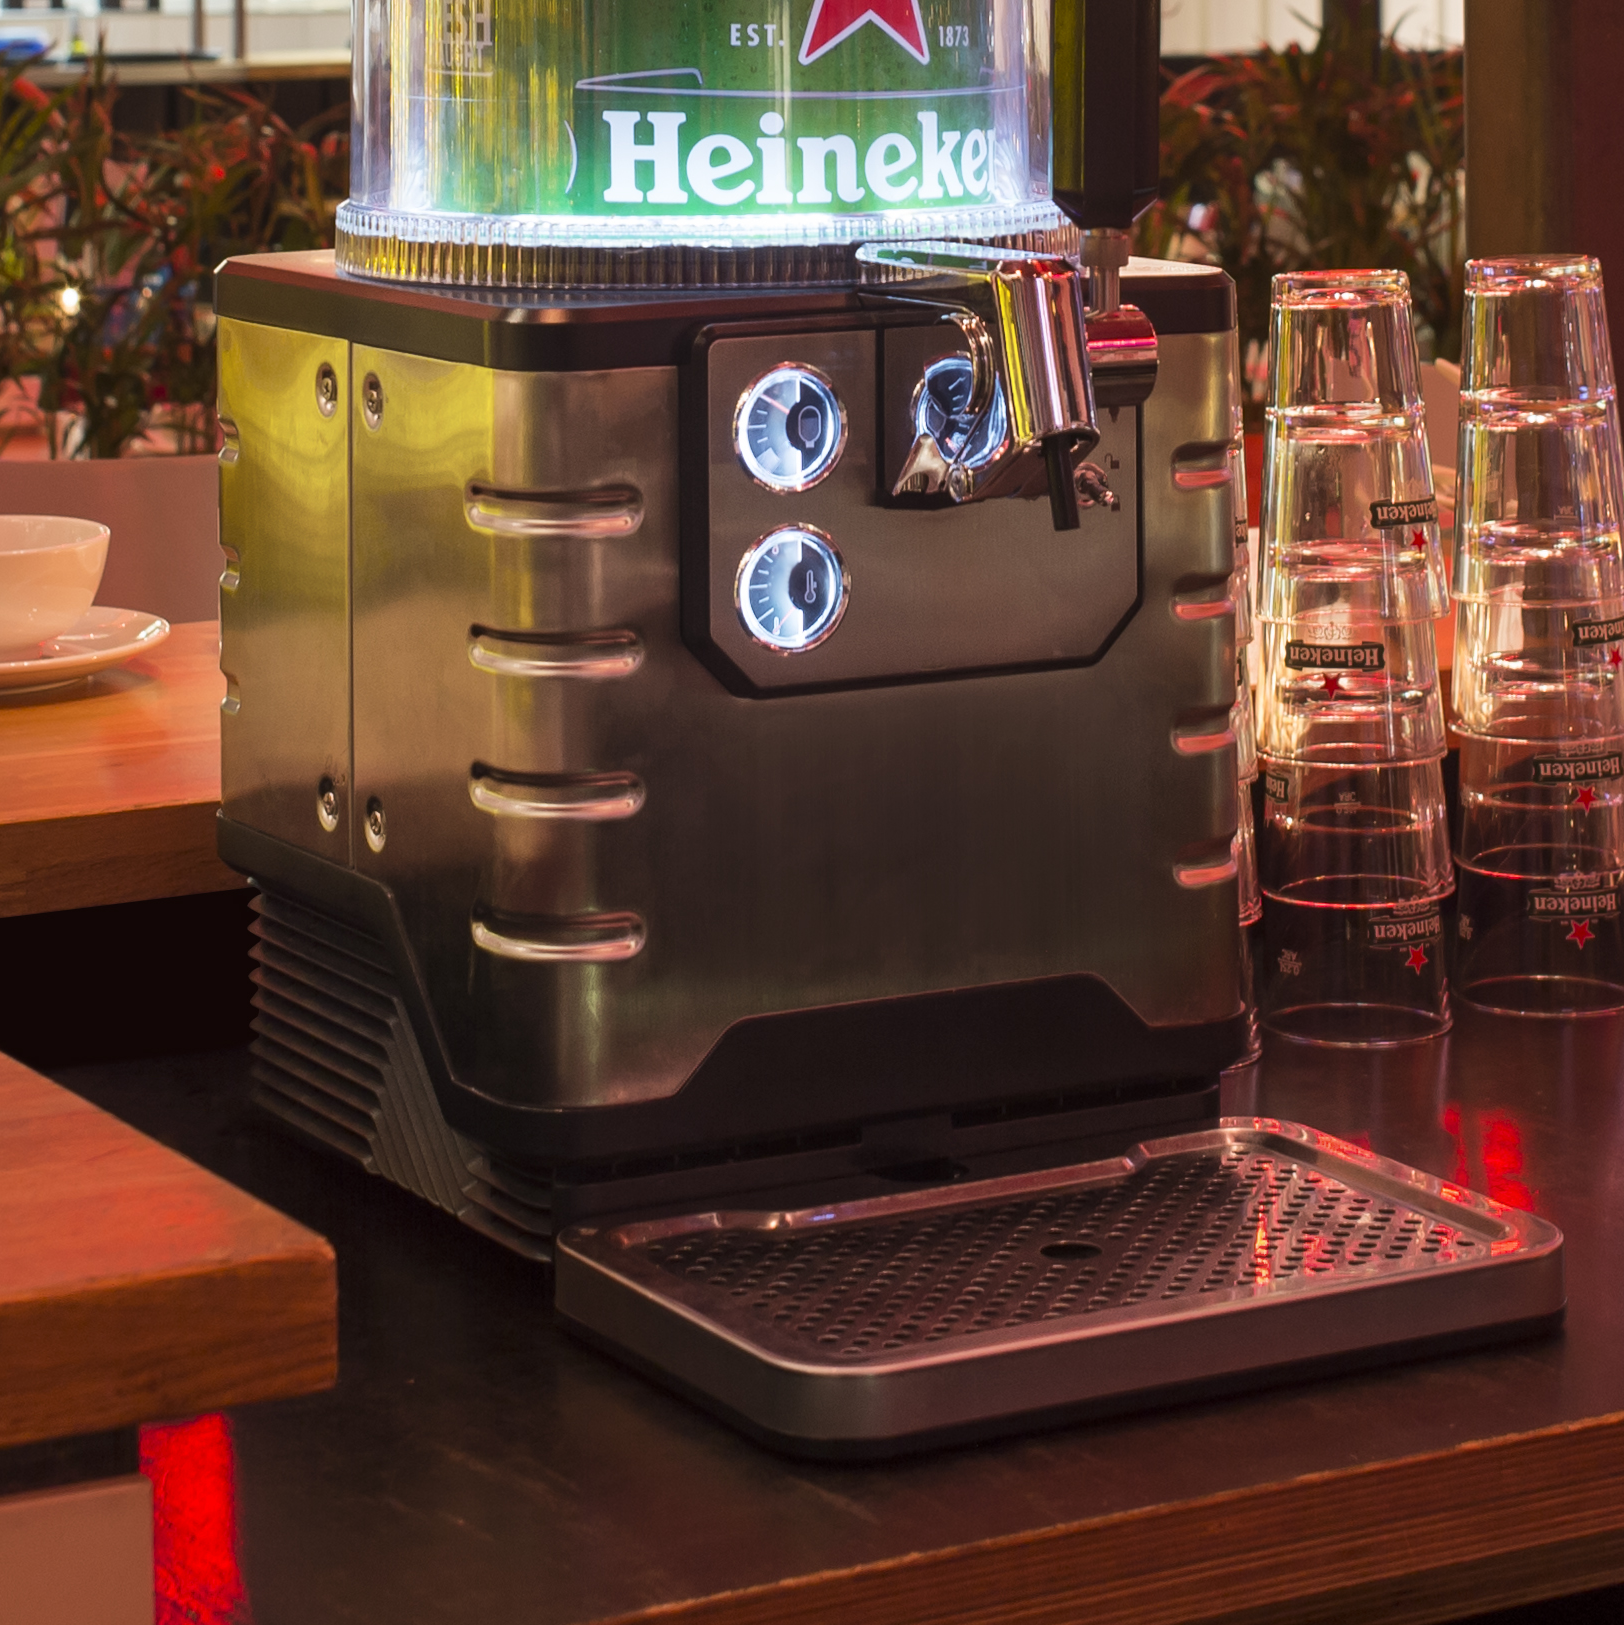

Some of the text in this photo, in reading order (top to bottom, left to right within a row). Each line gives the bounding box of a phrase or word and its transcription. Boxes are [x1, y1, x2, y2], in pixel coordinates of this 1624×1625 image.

[729, 22, 970, 48] EST. 1873
[1289, 646, 1379, 667] Heineken
[1539, 756, 1621, 779] Heineken
[1534, 893, 1617, 914] Heineken
